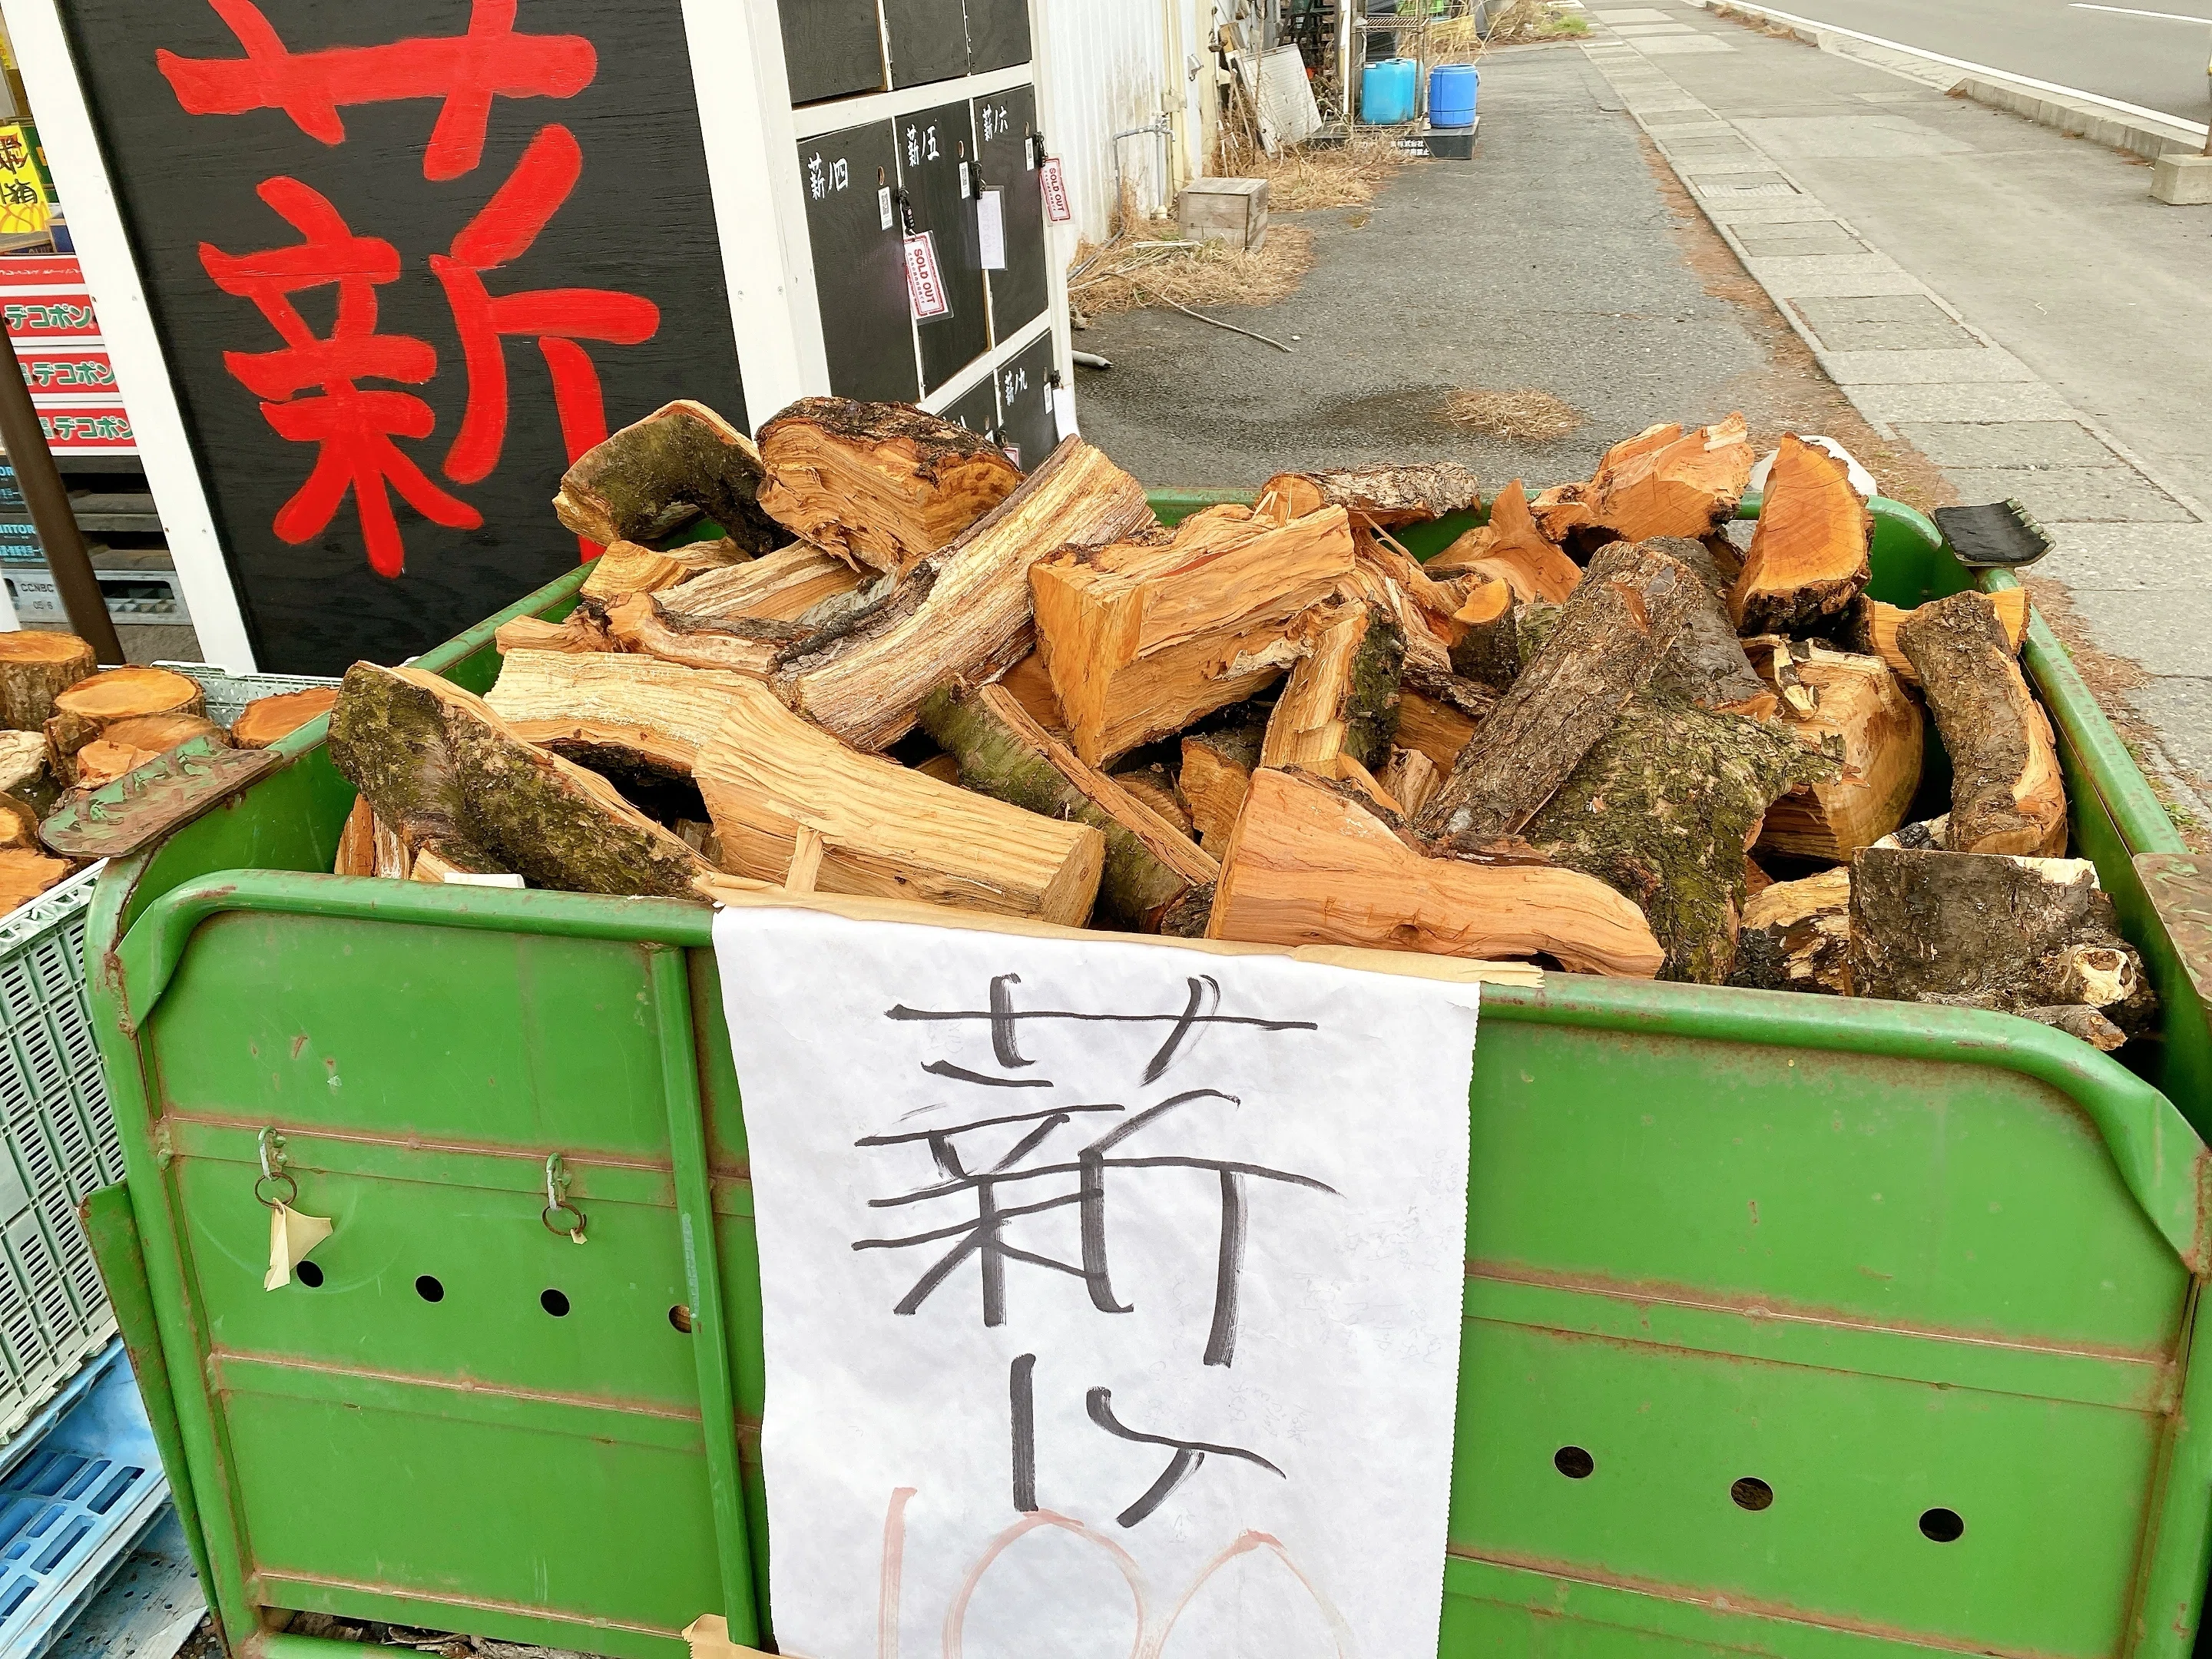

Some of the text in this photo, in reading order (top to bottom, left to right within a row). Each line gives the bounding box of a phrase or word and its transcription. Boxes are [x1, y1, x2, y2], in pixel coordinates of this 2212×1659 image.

[1049, 167, 1059, 191] SOLD
[1055, 194, 1065, 212] OUT
[155, 0, 661, 578] 薪
[914, 248, 929, 279] SOLD
[922, 282, 935, 303] OUT
[4, 303, 92, 330] デコポン
[20, 361, 116, 386] デコポン
[39, 416, 134, 440] デコポン
[851, 973, 1346, 1369] 薪
